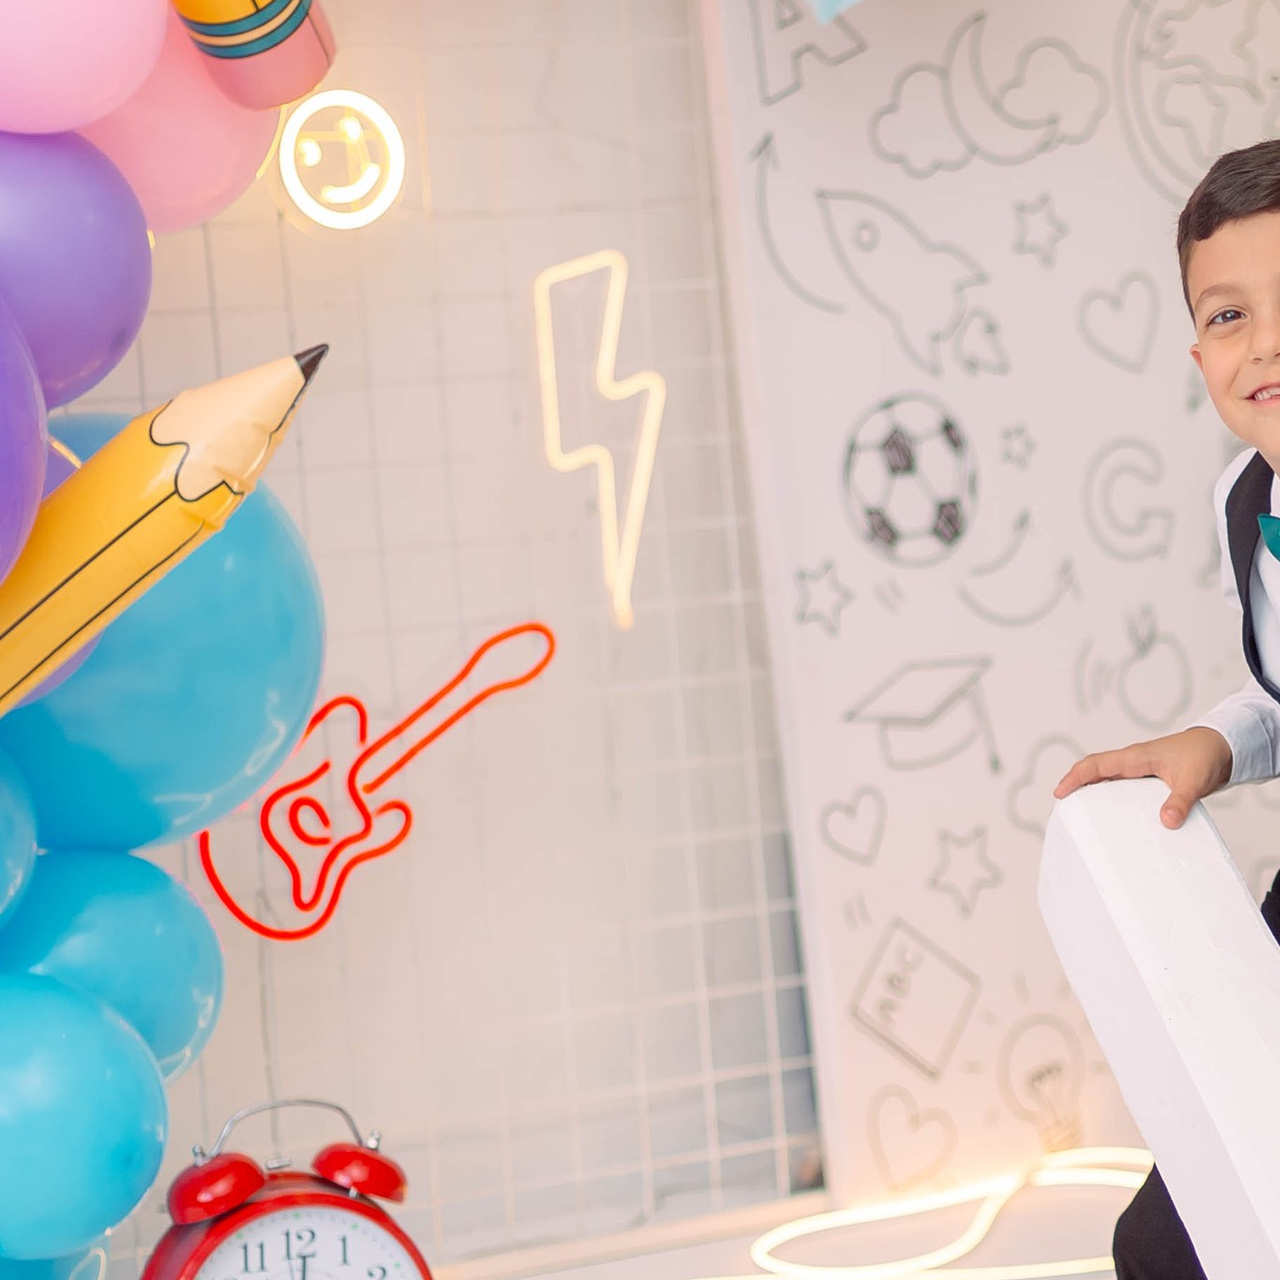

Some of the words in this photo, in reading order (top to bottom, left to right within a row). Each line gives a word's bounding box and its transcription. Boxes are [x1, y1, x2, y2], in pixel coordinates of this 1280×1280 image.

[1083, 436, 1175, 563] G
[240, 1241, 269, 1275] 11
[282, 1228, 317, 1261] 12
[337, 1234, 352, 1267] 1
